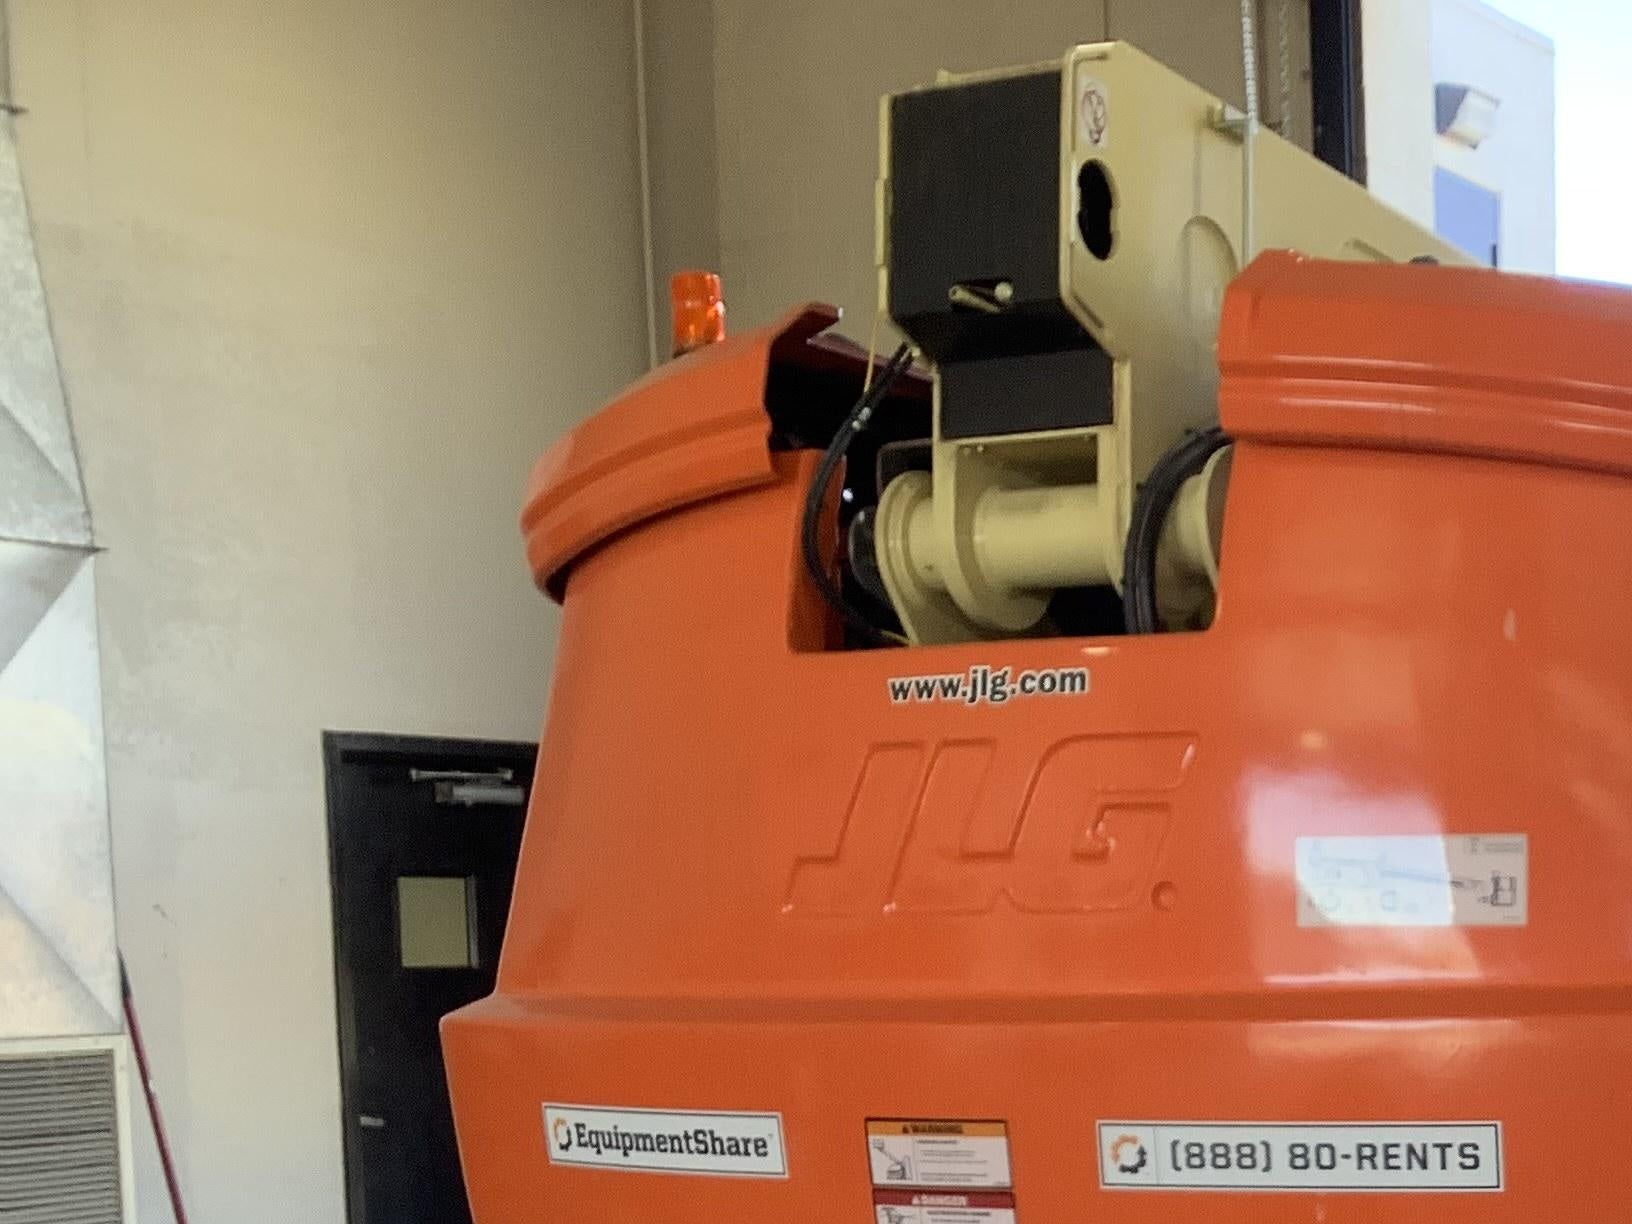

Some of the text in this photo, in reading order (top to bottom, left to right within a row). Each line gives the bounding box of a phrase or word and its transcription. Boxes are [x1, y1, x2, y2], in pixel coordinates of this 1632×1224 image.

[889, 668, 1087, 704] www.jlg.com
[780, 730, 1200, 915] JLG
[573, 1122, 769, 1158] EquipmentShare
[1170, 1139, 1481, 1173] (888) 80-RENTS
